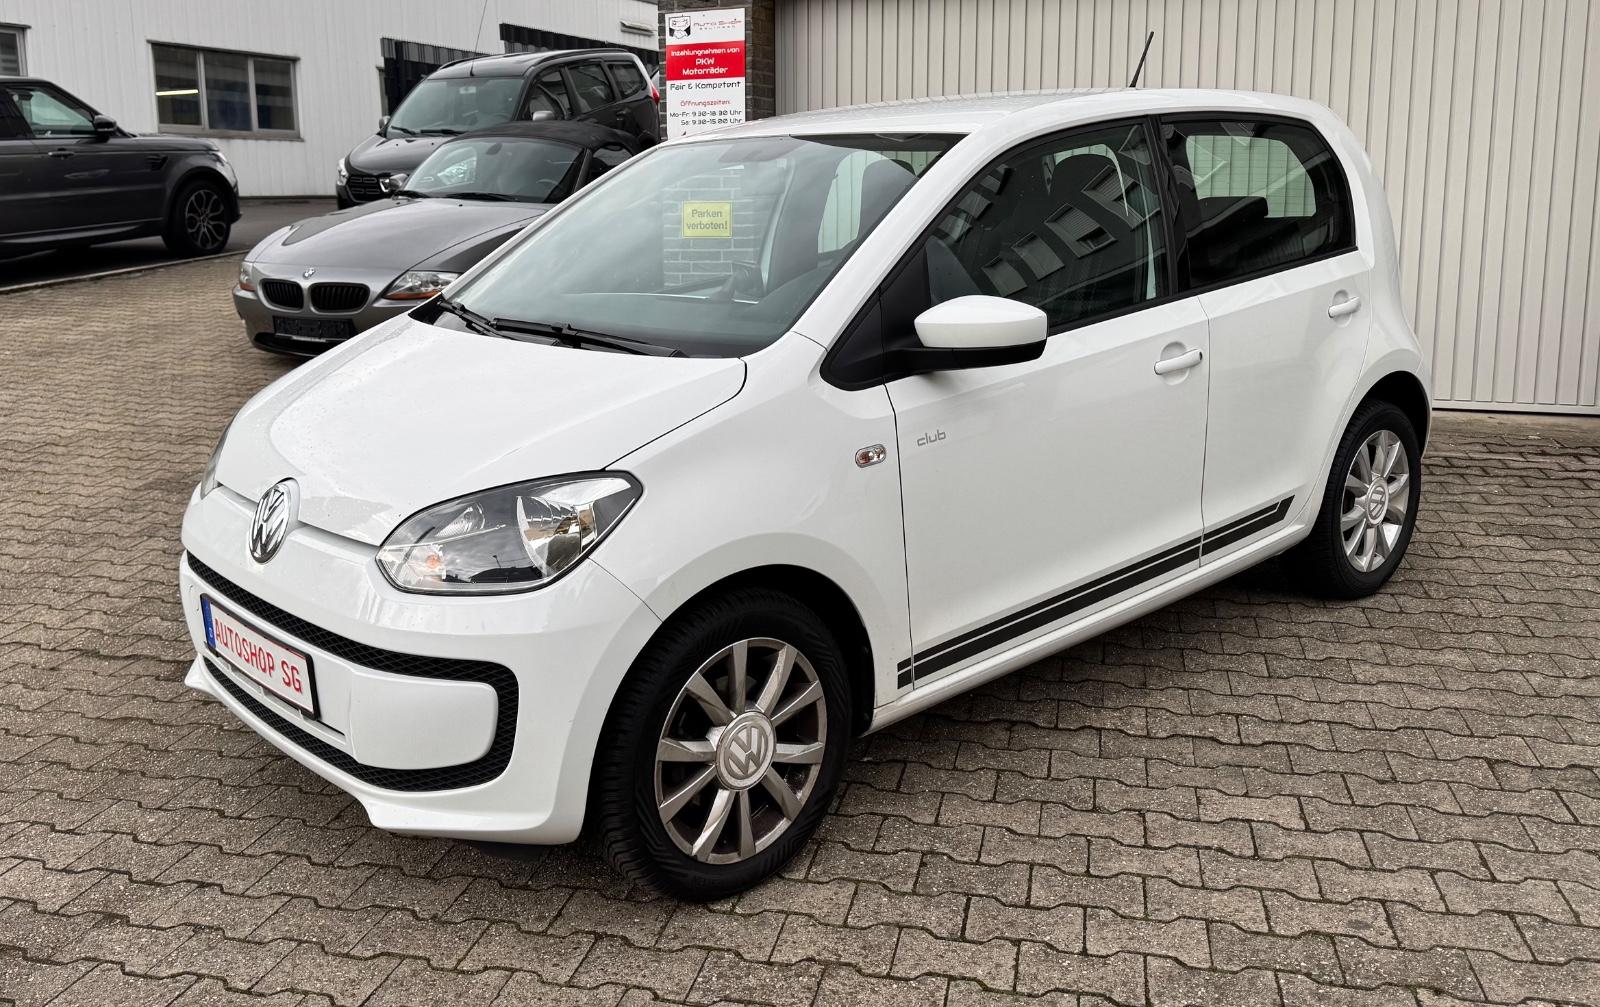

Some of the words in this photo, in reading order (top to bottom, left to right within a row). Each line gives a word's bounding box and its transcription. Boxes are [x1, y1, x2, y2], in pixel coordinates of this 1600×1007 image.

[695, 57, 715, 65] PKW
[682, 66, 728, 75] Motorräder
[695, 81, 741, 90] Kompetent
[691, 209, 723, 218] Parken
[686, 220, 728, 230] verboten!
[917, 429, 947, 447] club
[214, 618, 275, 678] AUTOSHOP
[281, 660, 303, 694] SG
